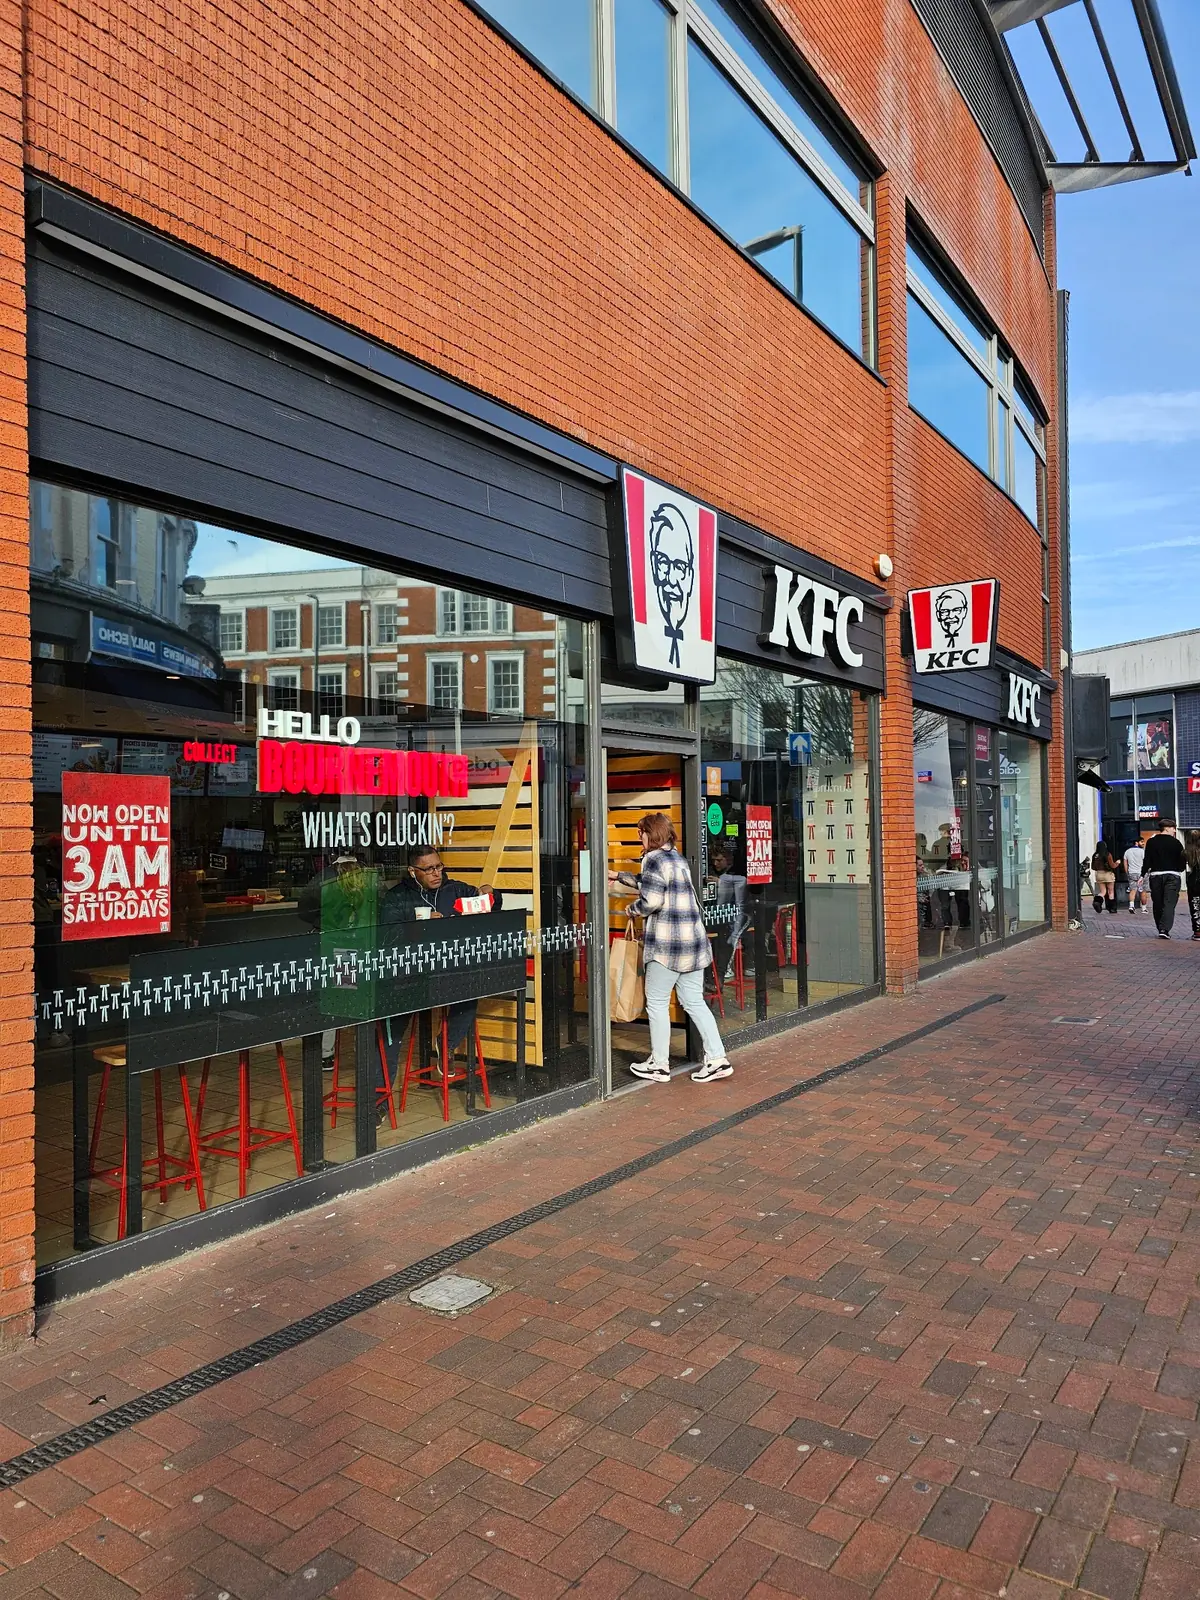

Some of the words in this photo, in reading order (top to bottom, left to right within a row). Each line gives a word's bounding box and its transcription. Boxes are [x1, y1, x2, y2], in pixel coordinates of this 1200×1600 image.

[769, 565, 864, 668] KFC
[926, 648, 979, 670] KFC
[1007, 672, 1041, 728] KFC
[258, 708, 361, 745] HELLO
[183, 741, 238, 764] COLLECT
[258, 740, 469, 798] BOURNEMOUTH
[63, 804, 109, 824] NOW
[115, 804, 169, 824] OPEN
[63, 825, 169, 842] UNTIL
[302, 811, 371, 848] WHAT'S
[375, 811, 455, 847] CLUCKIN'?
[746, 830, 772, 838] UNTIL
[746, 839, 772, 861] 3AM
[63, 844, 169, 892] 3AM
[63, 888, 169, 904] FRIDAYS
[63, 899, 169, 924] SATURDAYS
